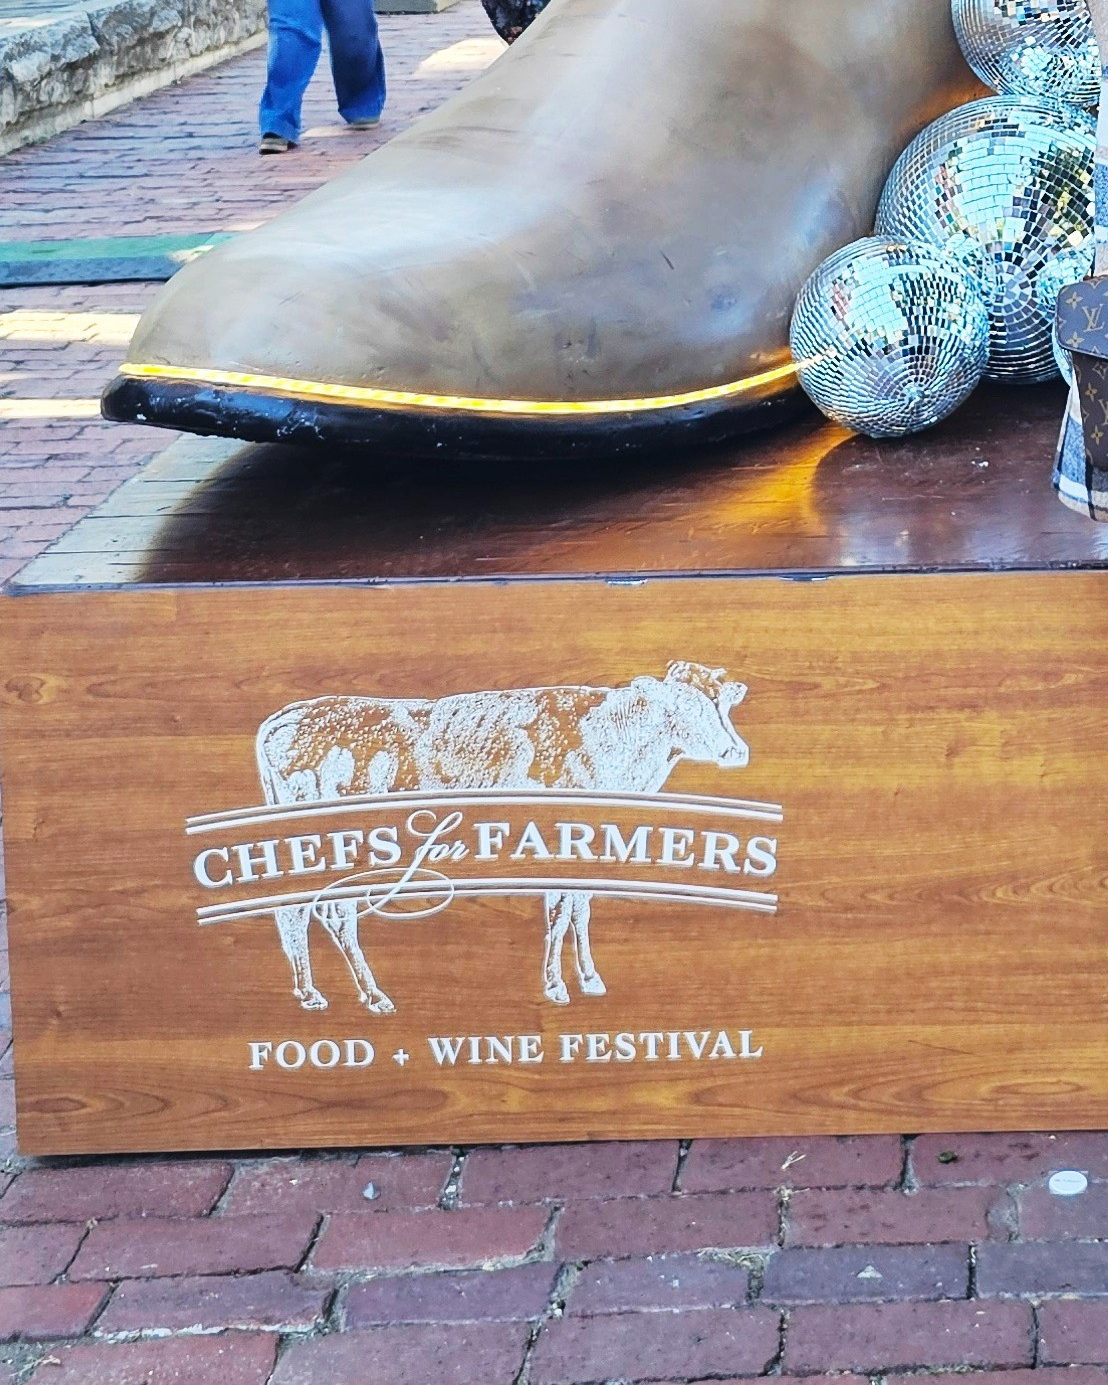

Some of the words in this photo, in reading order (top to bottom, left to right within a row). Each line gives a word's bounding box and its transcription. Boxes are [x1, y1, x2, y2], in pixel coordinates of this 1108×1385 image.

[193, 825, 402, 889] CHEFS
[472, 819, 778, 878] FARMERS
[248, 1038, 376, 1070] FOOD
[391, 1046, 410, 1067] +
[427, 1033, 545, 1067] WINE
[558, 1029, 763, 1064] FESTIVAL
